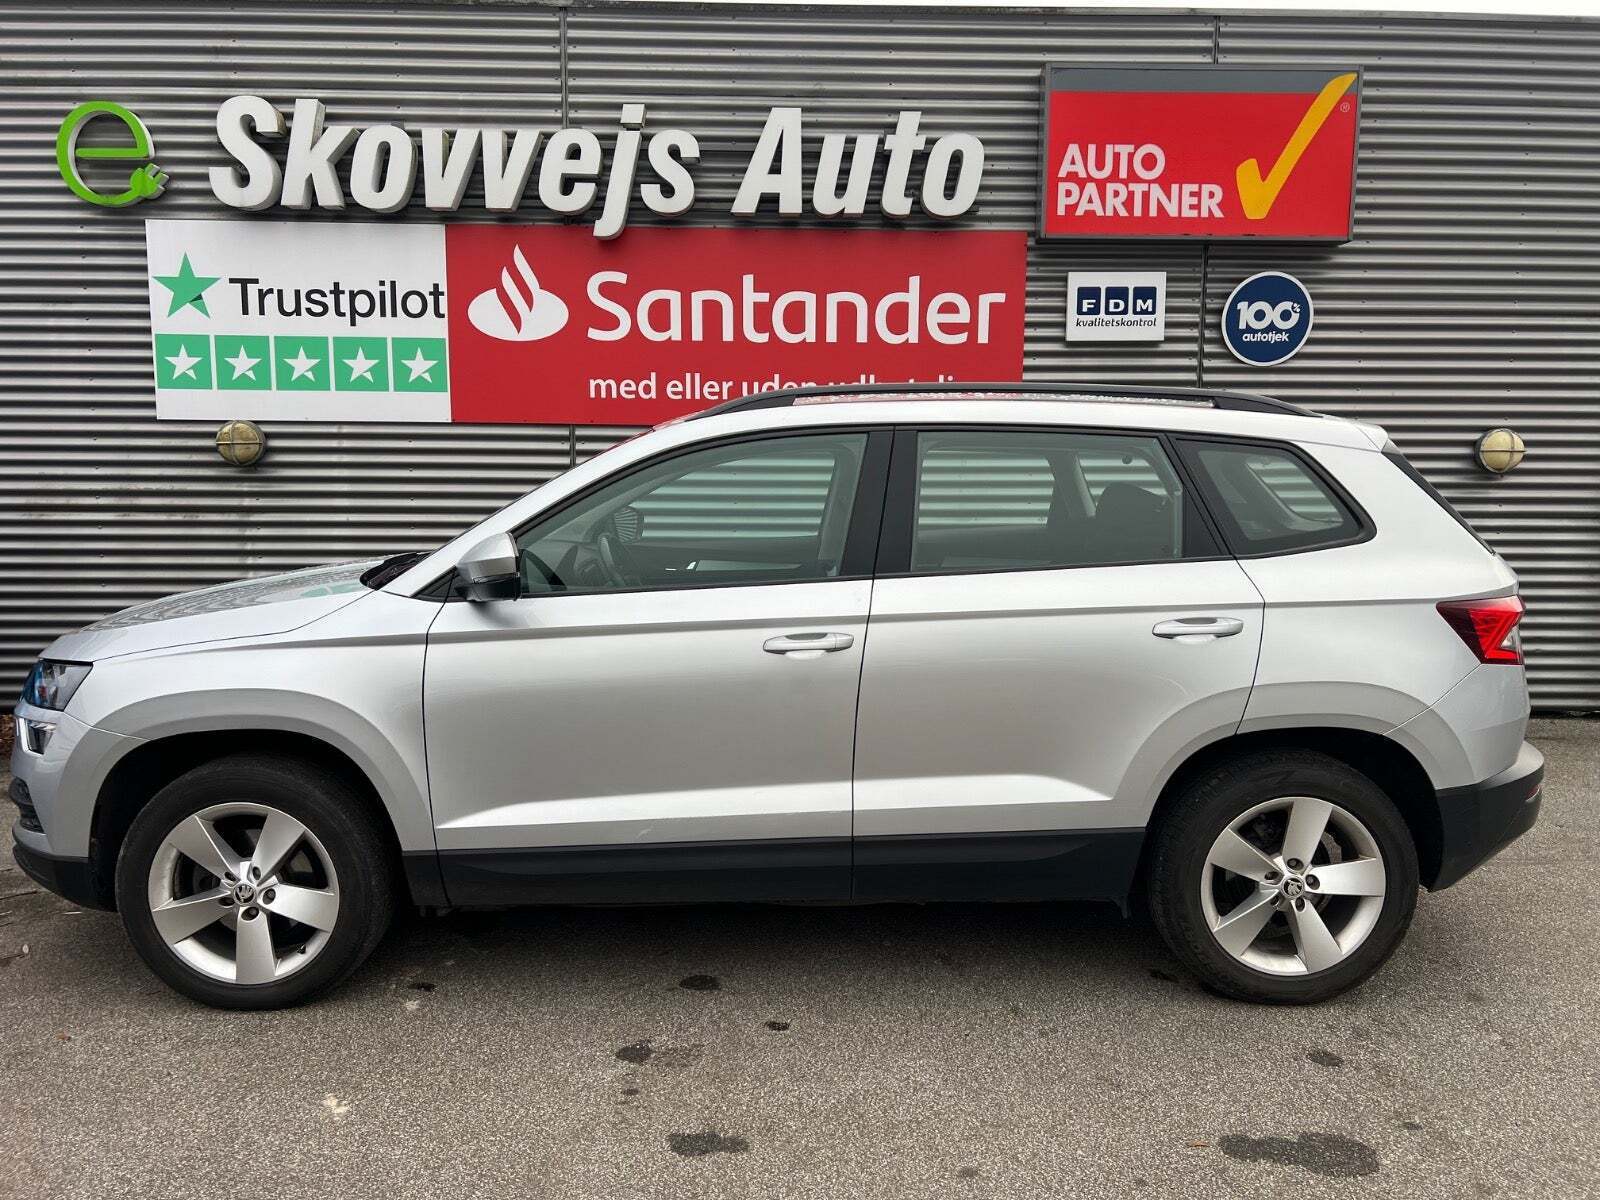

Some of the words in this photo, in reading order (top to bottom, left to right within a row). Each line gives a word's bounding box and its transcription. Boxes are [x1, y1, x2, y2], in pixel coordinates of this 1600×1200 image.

[209, 95, 700, 240] Skovvejs
[730, 107, 986, 219] Auto
[1057, 143, 1166, 180] AUTO
[1056, 182, 1225, 218] PARTNER
[229, 277, 445, 327] Trustpilot
[586, 270, 1006, 345] Santander
[1080, 297, 1155, 314] FDM
[1075, 317, 1157, 328] kvalitetskontrol
[1242, 331, 1290, 344] autotjek
[589, 372, 657, 399] med
[666, 372, 733, 400] eller
[741, 373, 816, 397] ud
